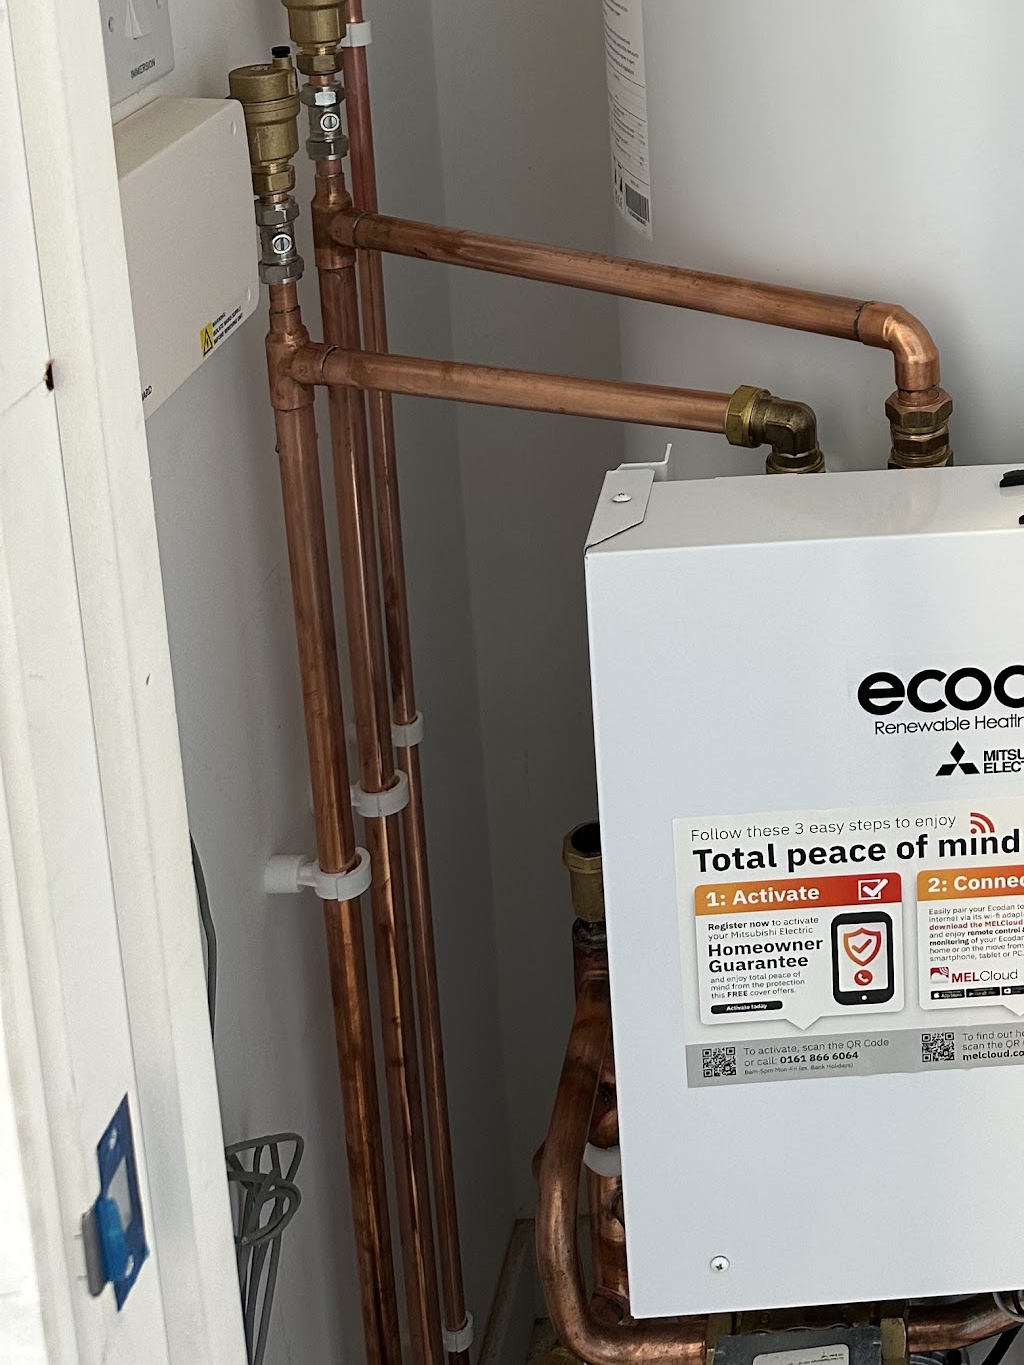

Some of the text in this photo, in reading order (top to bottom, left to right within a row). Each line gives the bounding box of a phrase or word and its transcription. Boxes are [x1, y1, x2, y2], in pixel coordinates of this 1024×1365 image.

[874, 716, 970, 734] Renewable
[691, 814, 956, 841] Follow these 3 easy steps to enjoy
[693, 844, 777, 872] Total
[787, 842, 886, 872] peace
[896, 834, 928, 859] of
[938, 828, 1020, 858] mind
[928, 877, 947, 893] 2:
[706, 887, 820, 907] 1: Activate
[929, 908, 950, 916] Easily
[953, 907, 967, 915] pair
[988, 904, 1015, 912] Ecodan
[708, 921, 747, 931] Register
[750, 920, 770, 928] now
[783, 917, 819, 925] activate
[929, 922, 968, 930] download
[985, 920, 1023, 928] MELCloud
[731, 929, 777, 938] Mitsubishi
[780, 927, 813, 936] Electric
[945, 930, 965, 938] enjoy
[708, 939, 823, 956] Homeowner
[709, 956, 809, 972] Guarantee
[727, 974, 747, 983] enjoy
[952, 969, 1018, 983] MELCloud
[766, 979, 805, 988] protection
[976, 1031, 994, 1040] find
[997, 1030, 1012, 1038] out
[744, 1039, 889, 1055] To activate, scan the QR Code
[962, 1042, 985, 1050] scan
[987, 1041, 1003, 1049] the
[1006, 1040, 1020, 1049] QR
[757, 1057, 777, 1065] call:
[780, 1055, 807, 1063] 0161
[809, 1053, 829, 1061] 866
[832, 1051, 858, 1060] 6064
